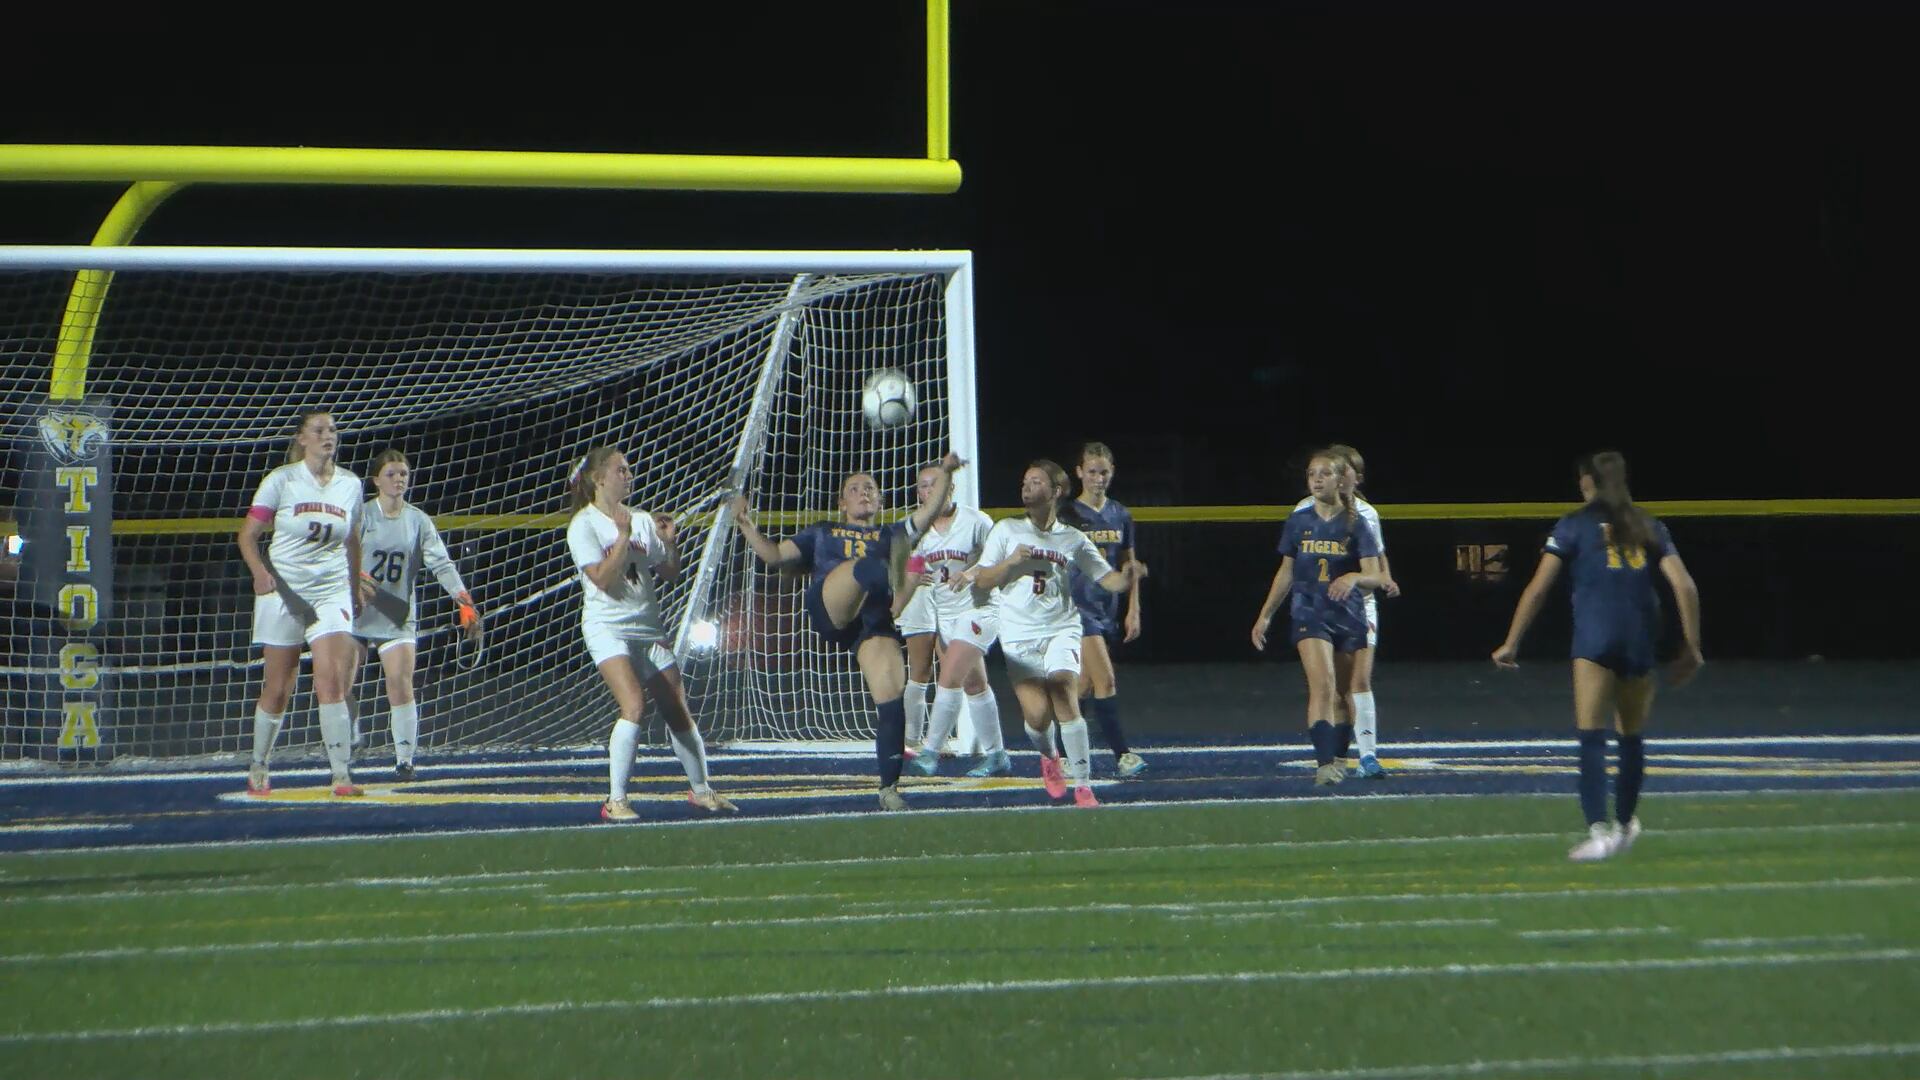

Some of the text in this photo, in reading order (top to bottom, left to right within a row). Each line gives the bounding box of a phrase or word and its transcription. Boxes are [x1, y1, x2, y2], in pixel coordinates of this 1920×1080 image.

[306, 521, 333, 543] 21
[831, 526, 880, 542] TIGERS
[1301, 539, 1348, 555] TIGERS
[370, 549, 405, 583] 26
[940, 566, 949, 583] 3
[1318, 558, 1330, 582] 2
[1033, 570, 1046, 595] 5
[55, 466, 101, 749] TIOGA
